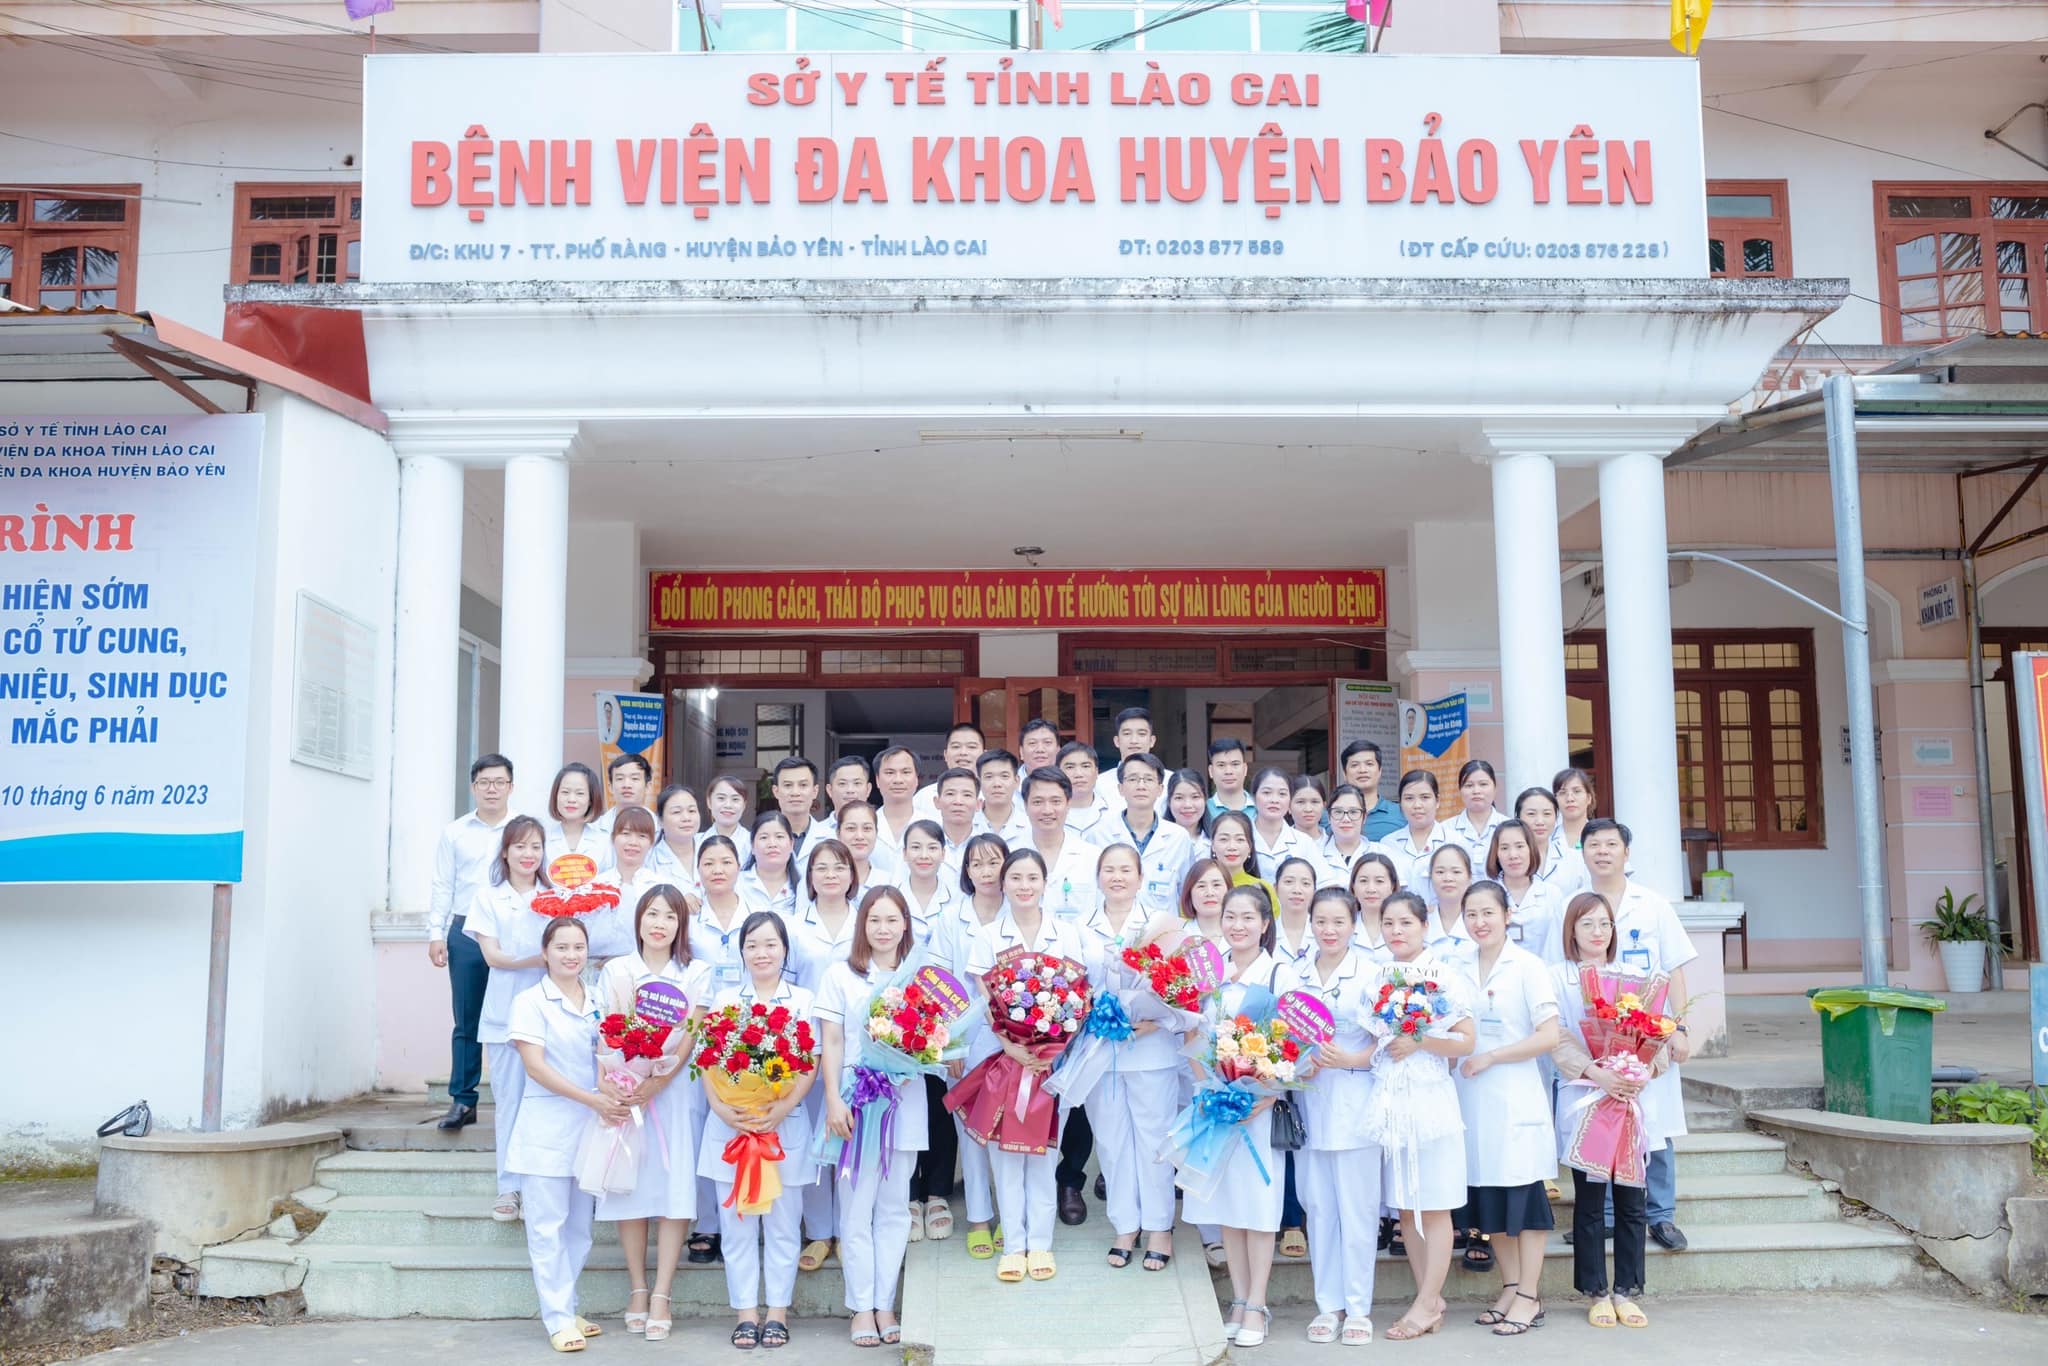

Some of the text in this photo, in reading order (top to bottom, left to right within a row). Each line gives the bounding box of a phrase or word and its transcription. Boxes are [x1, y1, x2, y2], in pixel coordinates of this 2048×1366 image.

[748, 58, 1319, 106] SỞ Y TẾ TỈNH LÀO CAI
[411, 113, 1653, 222] BỆNH VIỆN ĐA KHOA HUYỆN BẢO YÊN
[410, 244, 447, 260] Đ/C:
[454, 244, 493, 259] KHU
[501, 245, 511, 258] 7
[530, 243, 561, 260] TT.
[566, 240, 604, 257] PHỐ
[611, 242, 666, 257] RÀNG
[687, 239, 752, 259] HUYỆN
[757, 236, 796, 256] BẢO
[803, 237, 842, 256] YÊN
[863, 236, 906, 255] TỈNH
[912, 237, 949, 255] LÀO
[955, 240, 987, 255] CAI
[1119, 240, 1150, 255] ĐT:
[1157, 240, 1204, 255] 0203
[1441, 240, 1479, 257] CẤP
[1484, 237, 1531, 258] CỨU:
[1536, 244, 1581, 257] 0203
[24, 426, 34, 436] Y
[40, 421, 60, 436] TẾ
[63, 421, 98, 436] TỈNH
[104, 422, 135, 436] LÀO
[140, 425, 167, 436] CAI
[34, 446, 56, 456] ĐA
[62, 446, 106, 457] KHOA
[112, 441, 147, 456] TỈNH
[152, 441, 183, 456] LÀO
[188, 445, 215, 456] CAI
[20, 466, 42, 477] ĐA
[48, 466, 92, 477] KHOA
[98, 463, 151, 479] HUYỆN
[157, 462, 189, 477] BẢO
[194, 463, 226, 476] YÊN
[2, 576, 149, 616] HIỆN SỚM
[660, 570, 1376, 626] ĐỔI MỚI PHONG CÁCH, THÁI ĐỘ PHỤC VỤ CỦA CÁN BỘ Y TẾ HƯỚNG TỚI SỰ HÀI LÒNG CỦA NGƯỜI BỆNH
[4, 617, 187, 656] CỔ TỬ CUNG,
[0, 667, 228, 704] NIỆU, SINH DỤC
[11, 705, 159, 744] MẮC PHẢI
[1, 784, 209, 811] 10 tháng 6 năm 2023
